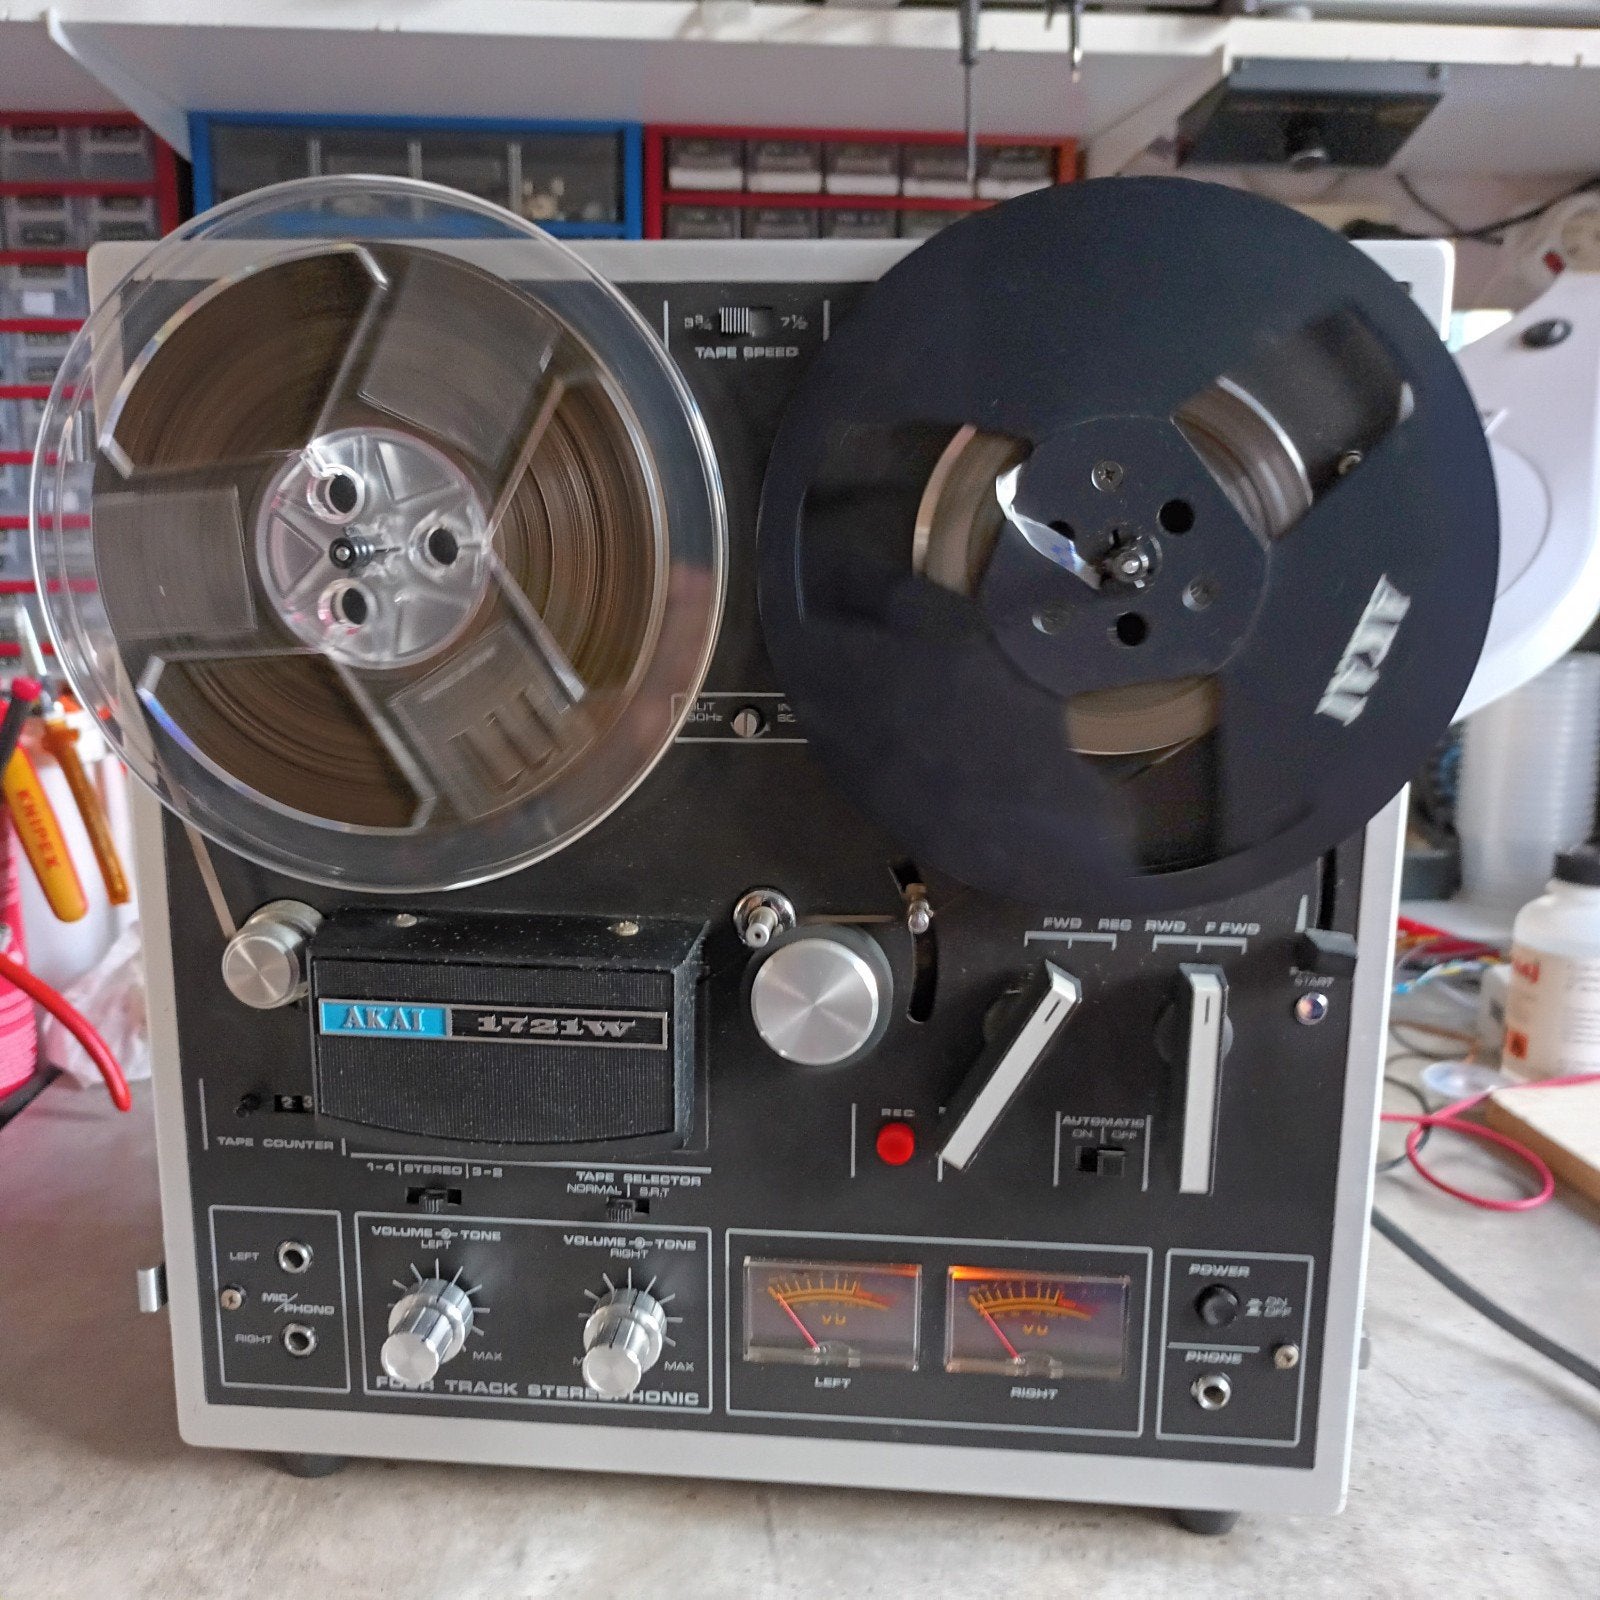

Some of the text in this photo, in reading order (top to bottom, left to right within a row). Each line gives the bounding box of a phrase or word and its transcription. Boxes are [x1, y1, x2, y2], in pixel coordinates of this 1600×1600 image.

[695, 346, 799, 360] TAPE SPEED
[1043, 916, 1082, 930] FWD
[1144, 919, 1187, 933] RWD
[1219, 921, 1260, 935] FWD
[1294, 976, 1335, 988] START
[343, 1004, 425, 1032] AKAI
[477, 1013, 637, 1038] 1721W
[881, 1108, 916, 1117] REC
[1061, 1114, 1145, 1128] AUTOMATIC
[1072, 1128, 1093, 1138] ON
[1111, 1129, 1137, 1140] OFF
[216, 1136, 334, 1150] TAPE COUNTER
[404, 1163, 463, 1176] STEREO
[575, 1170, 702, 1187] TAPE SELECTOR
[566, 1183, 623, 1195] NORMAL
[371, 1225, 502, 1242] VOLUME TONE
[421, 1239, 451, 1250] LEFT
[563, 1234, 697, 1251] VOLUME TONE
[229, 1251, 260, 1262] LEFT
[610, 1248, 649, 1260] RIGHT
[1188, 1263, 1250, 1278] POWER
[234, 1333, 273, 1344] RIGHT
[472, 1351, 502, 1361] MAX
[1184, 1350, 1243, 1365] PHONE
[664, 1360, 695, 1373] MAX
[814, 1376, 851, 1389] LEFT
[445, 1379, 518, 1396] TRACK
[527, 1383, 699, 1406] STEREHONIC
[1009, 1386, 1059, 1400] RIGHT
